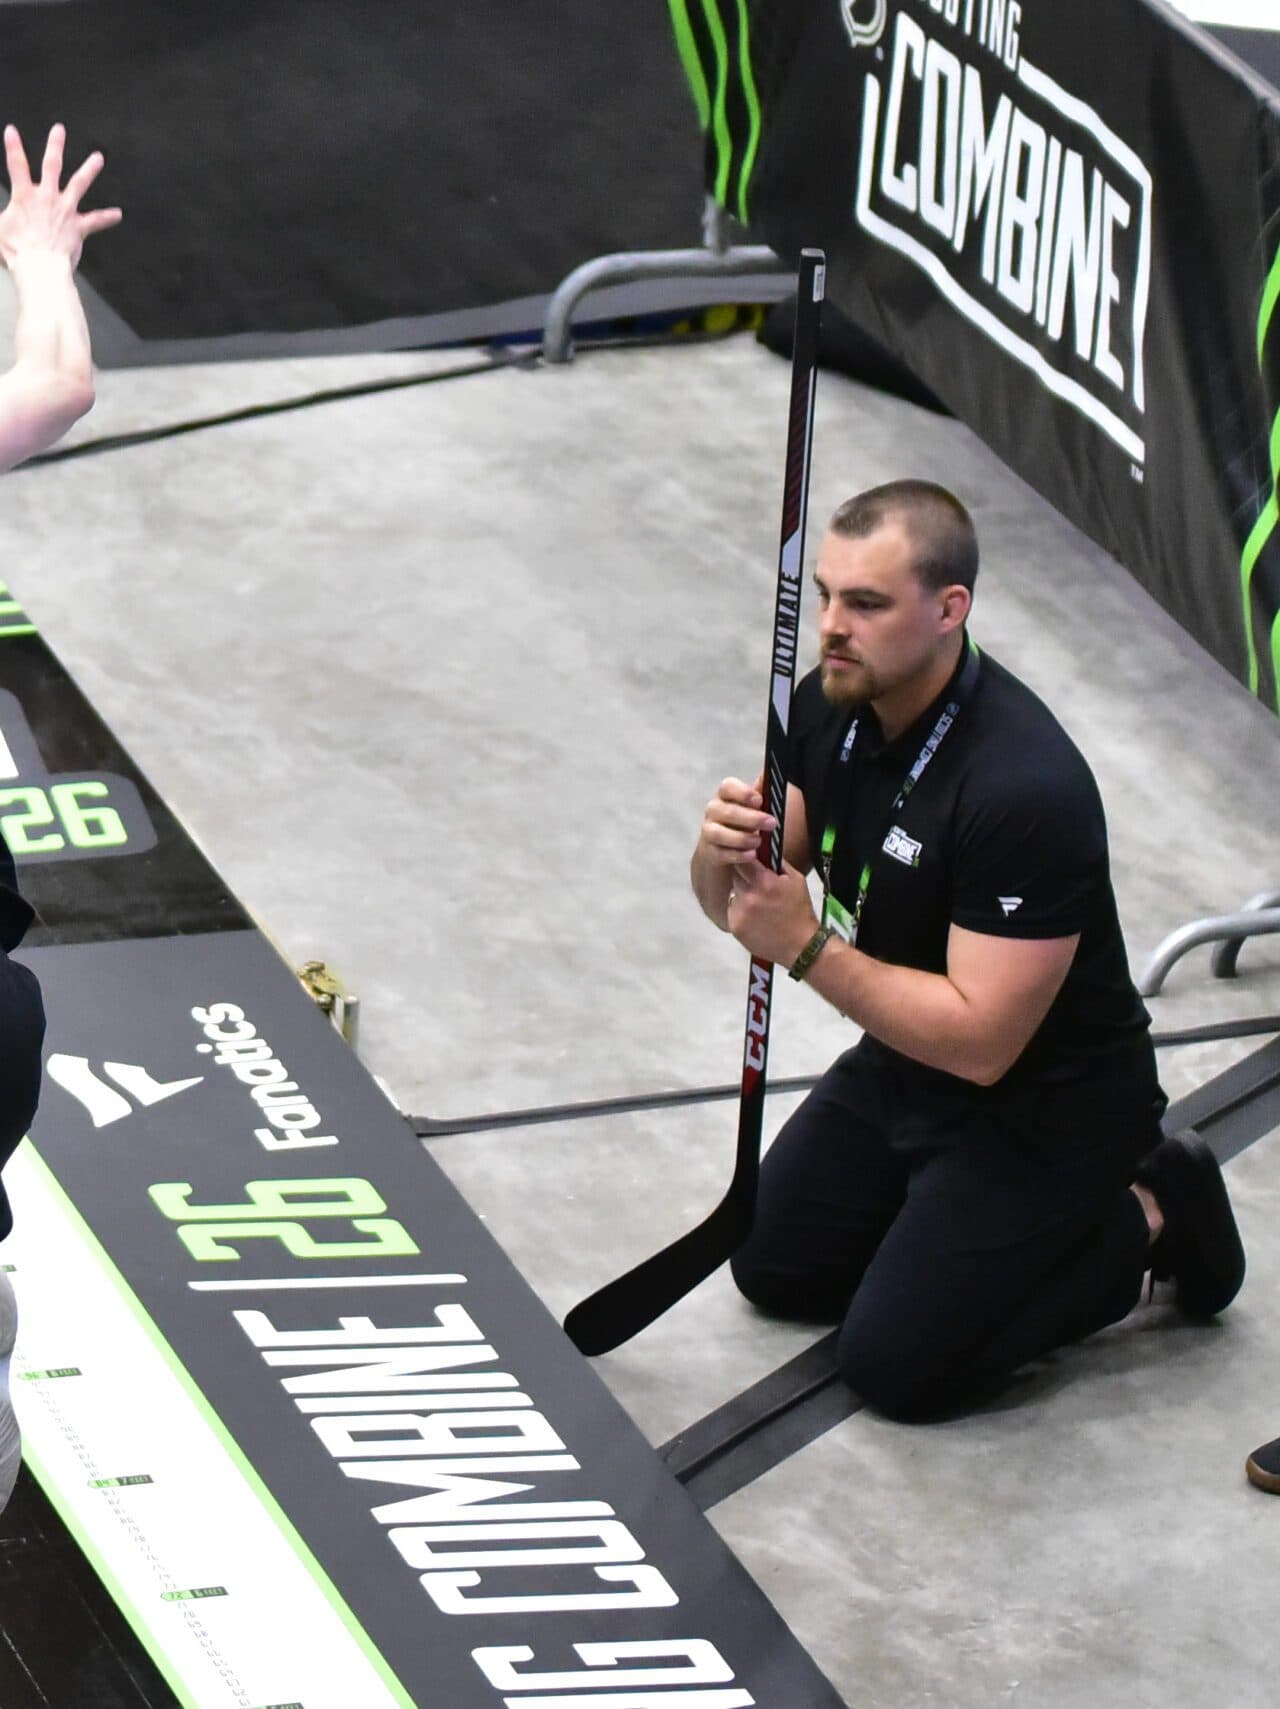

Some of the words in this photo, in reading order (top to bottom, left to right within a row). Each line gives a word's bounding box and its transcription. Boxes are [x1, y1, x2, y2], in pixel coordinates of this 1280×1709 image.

[880, 11, 1131, 392] COMBINE
[774, 571, 800, 678] ULTIMATE
[191, 1002, 339, 1151] Fanatics
[745, 963, 771, 1072] CCM
[148, 1177, 420, 1261] 26
[232, 1303, 679, 1614] COMBINE
